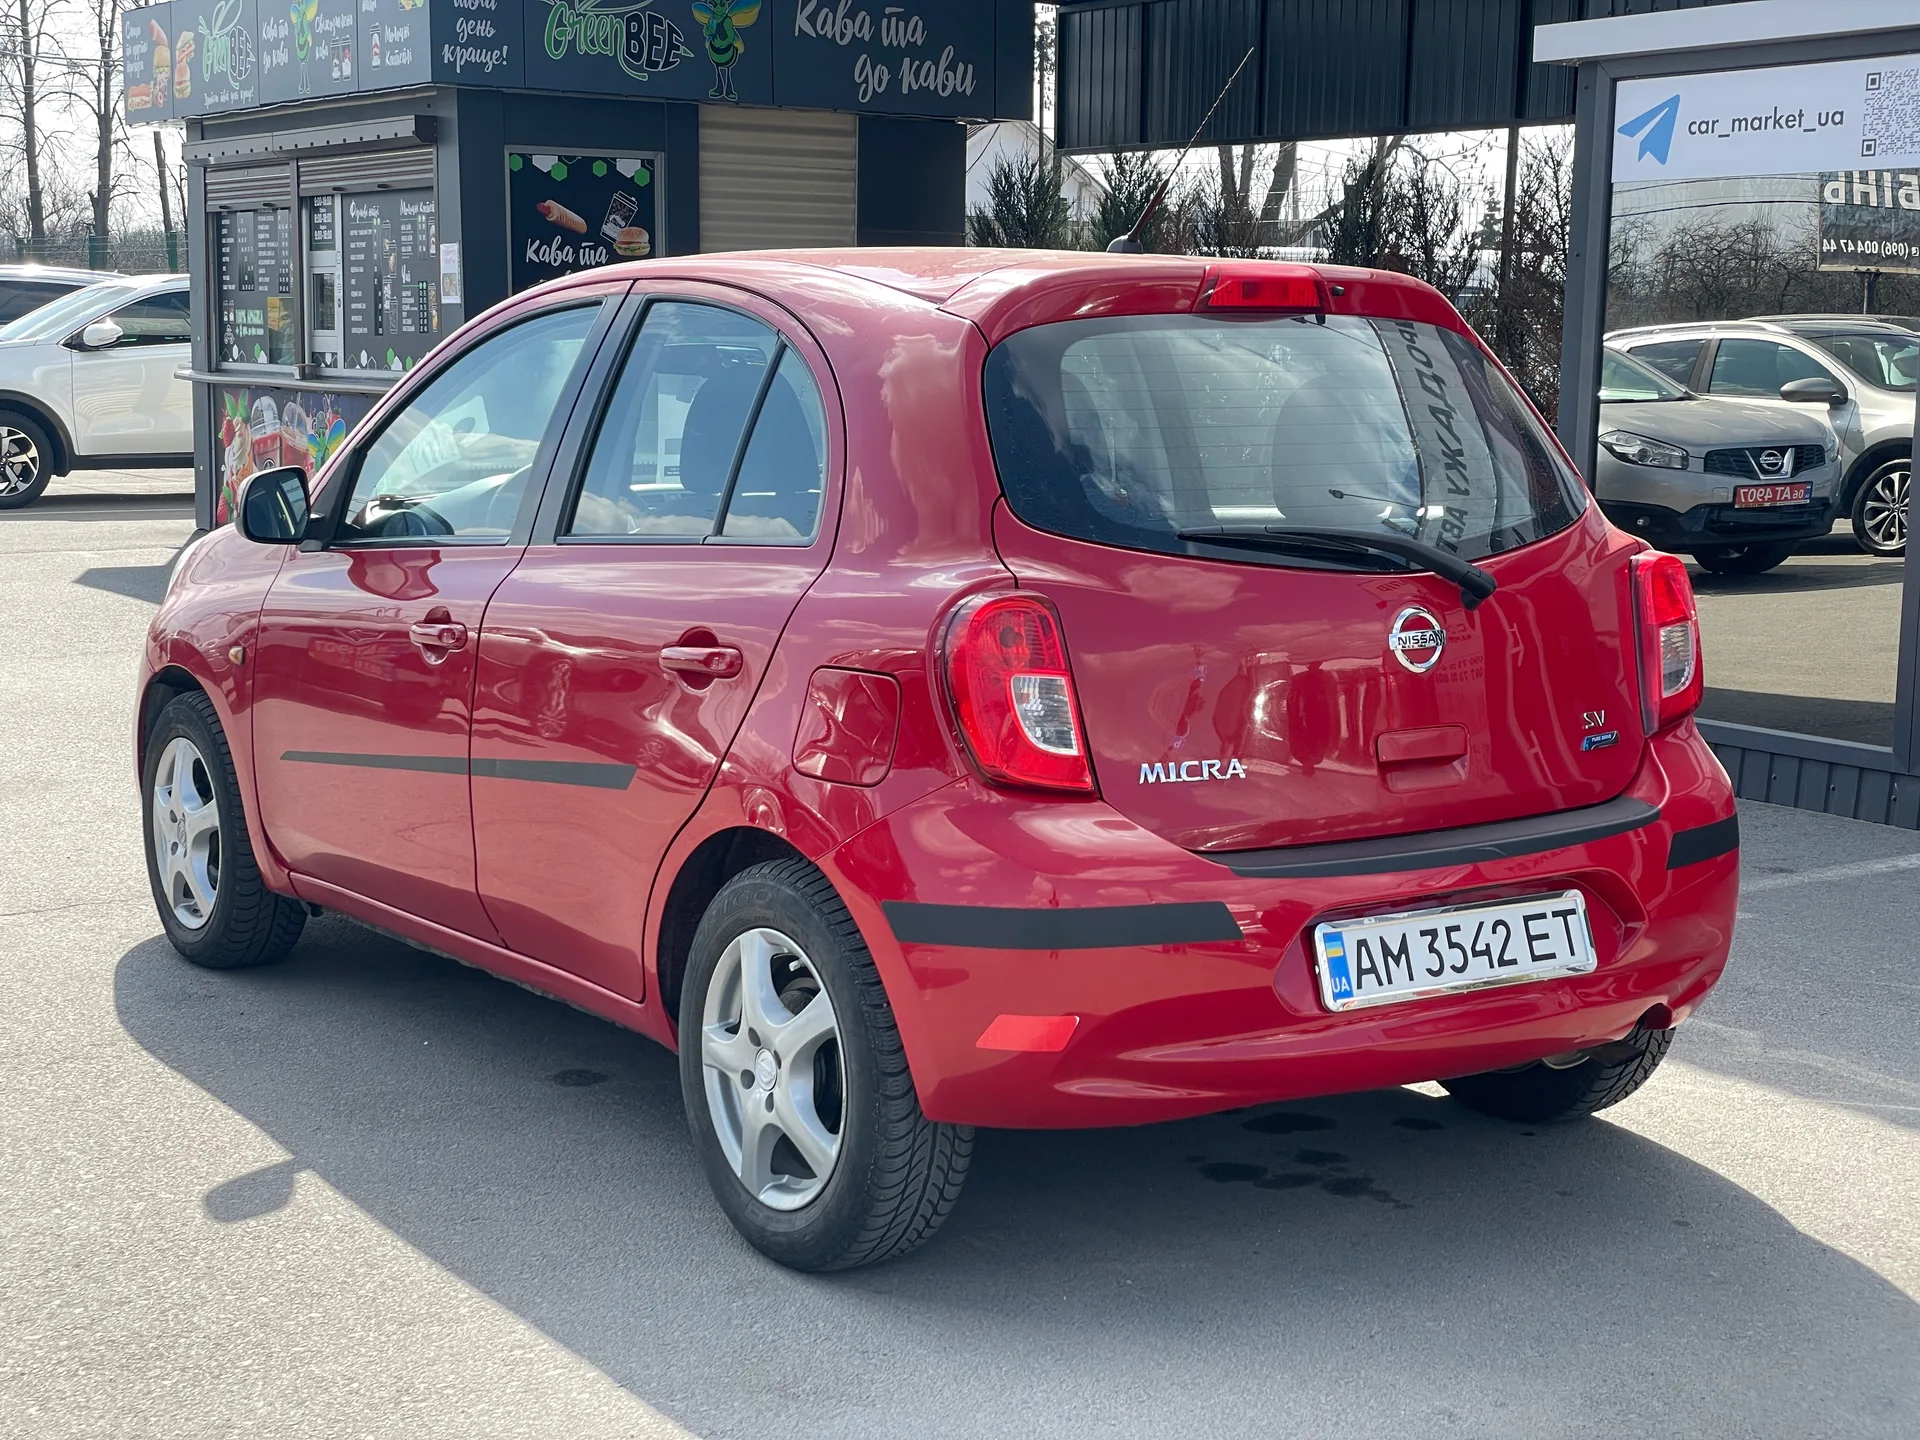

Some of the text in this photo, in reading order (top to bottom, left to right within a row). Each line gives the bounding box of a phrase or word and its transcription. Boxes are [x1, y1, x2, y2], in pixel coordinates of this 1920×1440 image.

[456, 17, 496, 43] день
[794, 0, 927, 48] Кава та
[442, 44, 508, 73] краще!
[854, 45, 976, 103] до кави
[1687, 105, 1845, 139] car_market_ua
[526, 235, 609, 267] Кава та
[1397, 630, 1445, 647] NISSAN
[1582, 709, 1605, 729] SV
[1139, 758, 1246, 784] MICRA
[1357, 908, 1578, 990] AM 3542 ET
[1332, 977, 1350, 993] UA
